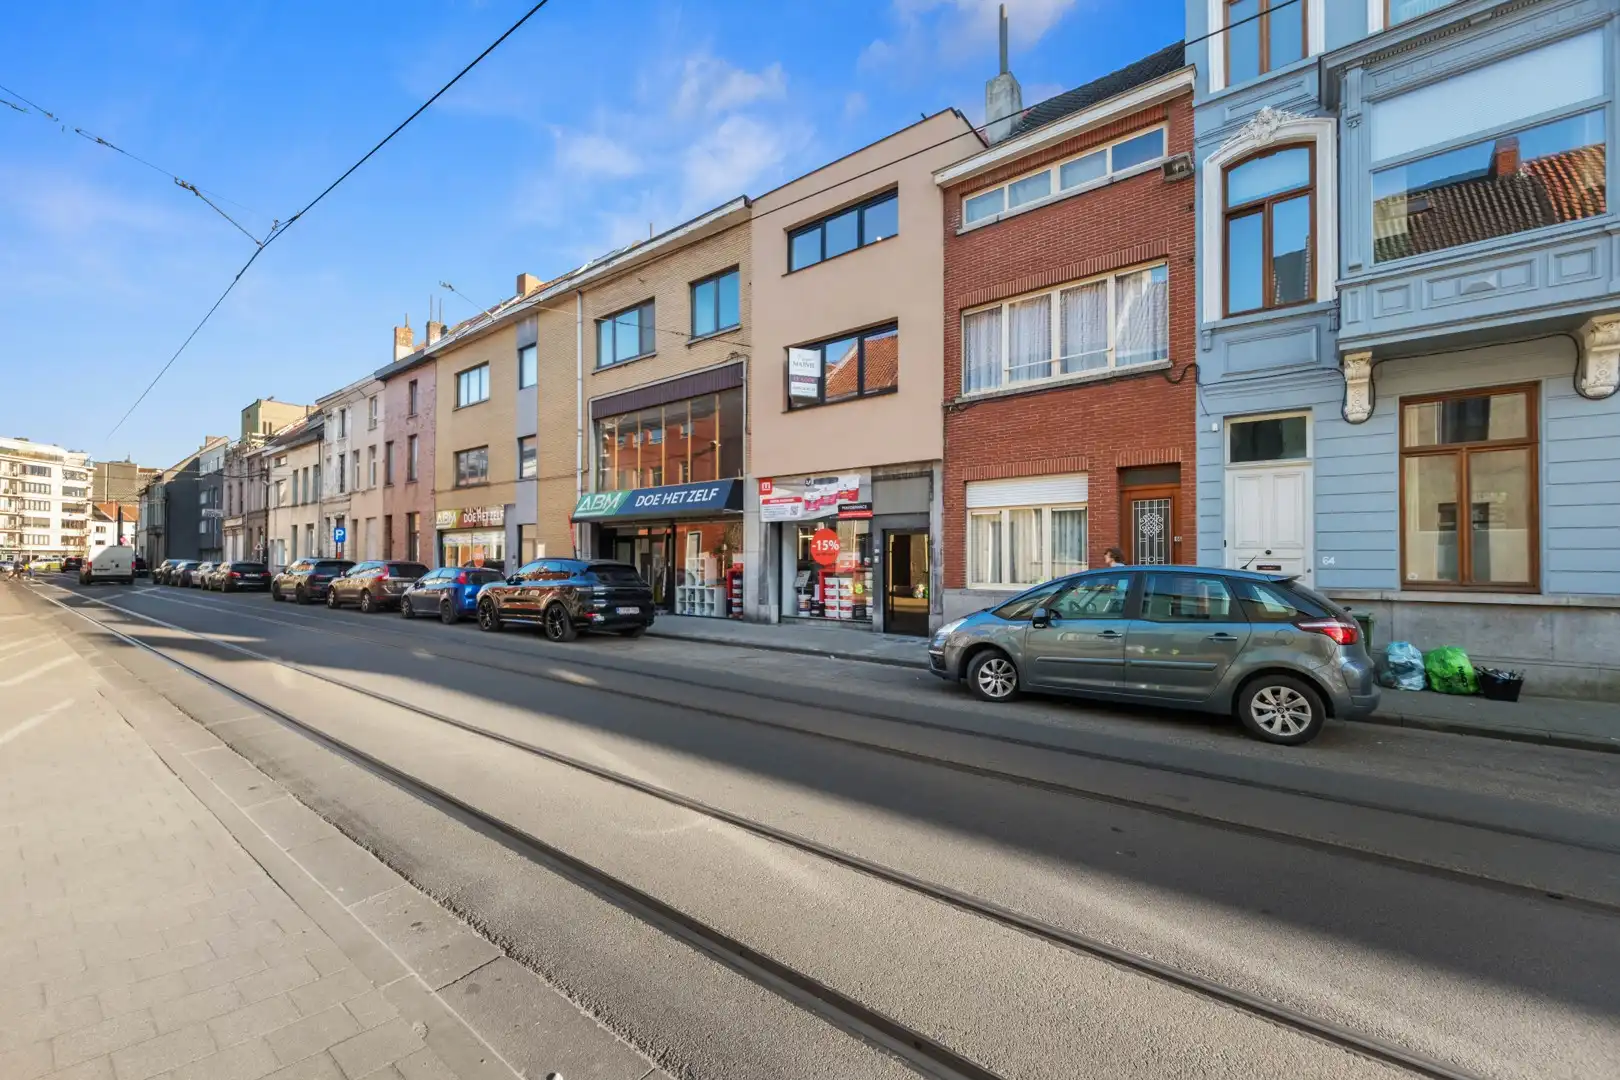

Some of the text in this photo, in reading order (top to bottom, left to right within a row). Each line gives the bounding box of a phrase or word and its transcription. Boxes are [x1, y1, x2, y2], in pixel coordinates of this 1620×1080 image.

[578, 492, 622, 512] ABM
[635, 488, 720, 507] DOE HET ZELF
[436, 512, 457, 524] ABM
[463, 509, 504, 523] DOE HET ZELF
[335, 529, 344, 540] P
[811, 539, 840, 551] -15%
[1322, 556, 1335, 565] 64
